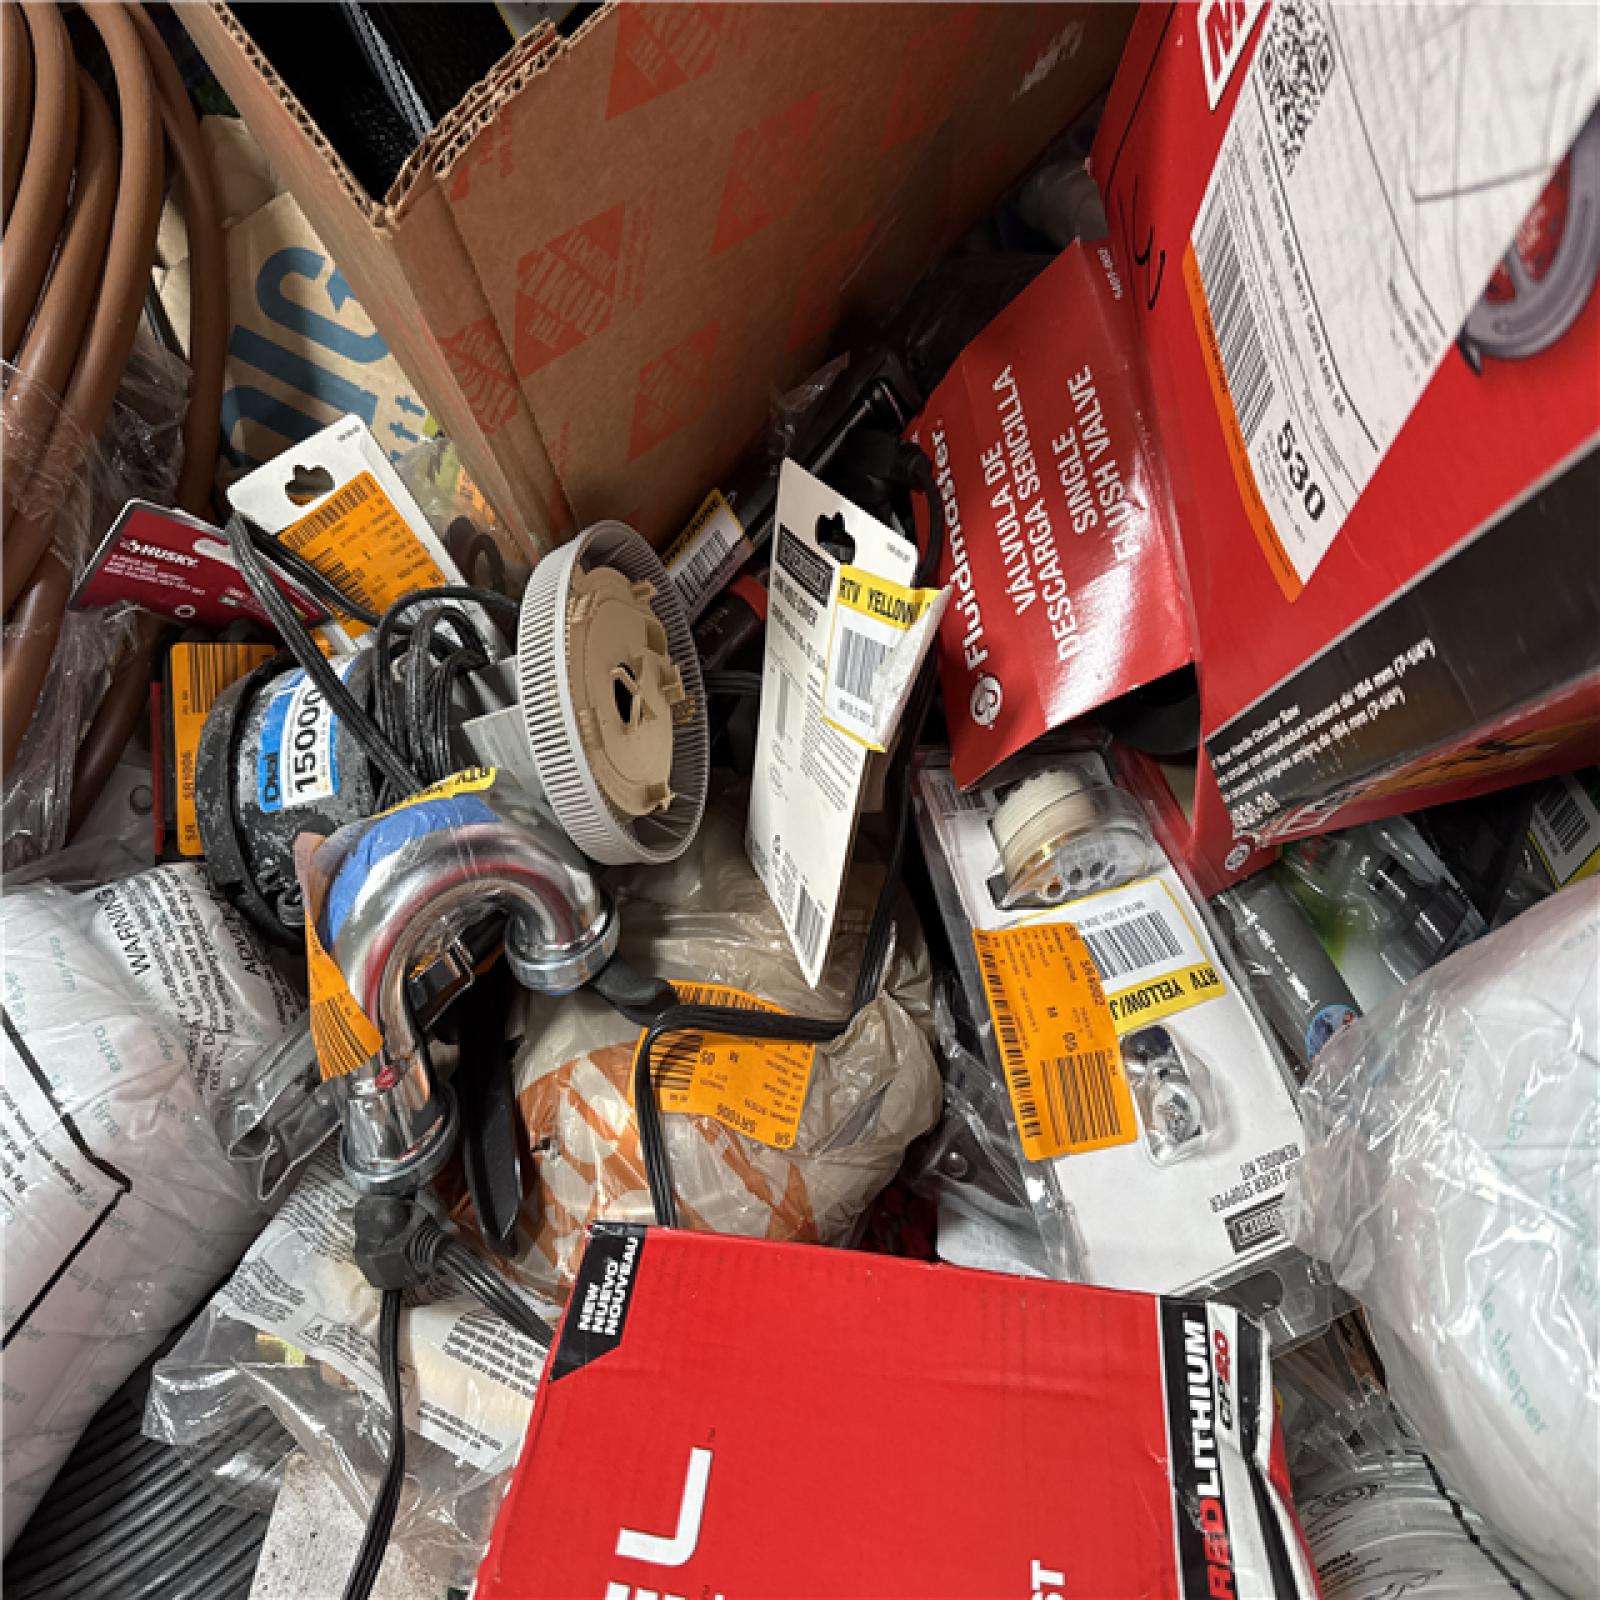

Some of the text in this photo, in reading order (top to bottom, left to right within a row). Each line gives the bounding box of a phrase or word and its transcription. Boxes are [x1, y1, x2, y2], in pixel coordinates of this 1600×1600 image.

[1066, 363, 1111, 461] VALVE
[992, 363, 1082, 659] DESCARGA SENCILLA
[1051, 426, 1097, 533] SINGLE
[1275, 418, 1328, 524] 530
[140, 543, 199, 570] HUSKY
[931, 429, 987, 669] Fluidmaster
[979, 441, 1035, 614] VÁLVULA DE
[837, 577, 861, 603] RTV
[1345, 707, 1370, 730] mm
[1350, 676, 1376, 700] 184
[1370, 665, 1397, 688] mm
[93, 886, 151, 975] WARNING
[1108, 967, 1219, 1019] RTV YELLOW/J
[1208, 1181, 1253, 1213] STOPPER
[1252, 1168, 1283, 1194] LEVER
[577, 1282, 599, 1330] NEW
[590, 1258, 618, 1332] NUEVO
[604, 1235, 638, 1335] NOUVEAU
[1489, 1325, 1550, 1436] sleeper
[1182, 1318, 1234, 1600] REDLITHIUM
